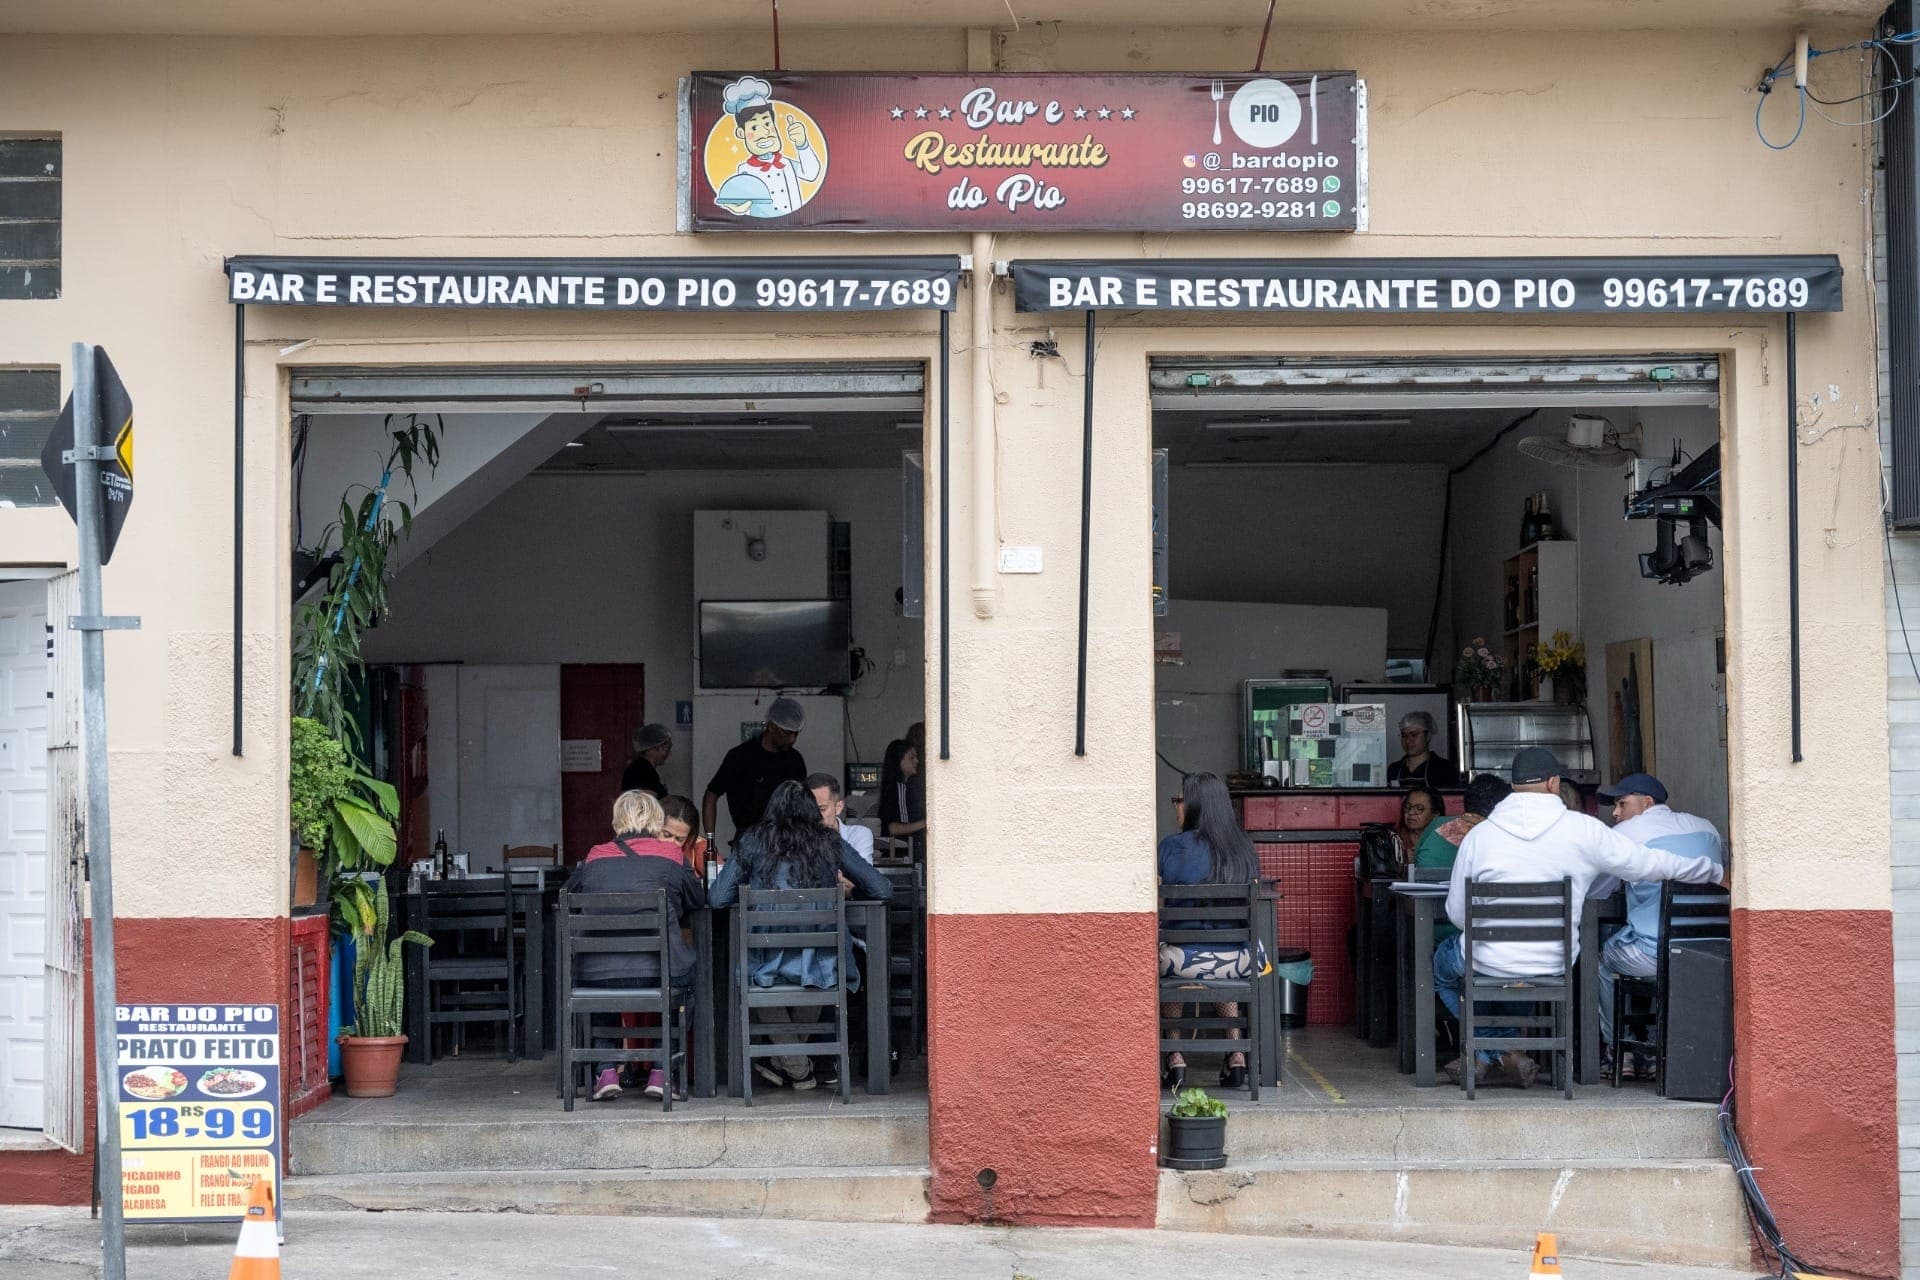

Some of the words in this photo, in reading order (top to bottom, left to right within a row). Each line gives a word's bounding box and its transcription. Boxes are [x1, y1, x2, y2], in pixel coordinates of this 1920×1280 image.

[961, 87, 1039, 128] Bar
[1045, 100, 1064, 123] e
[1250, 105, 1279, 123] PIO
[904, 131, 1109, 173] Restaurante
[1203, 152, 1339, 171] @_bardopio
[948, 176, 987, 208] do
[996, 174, 1065, 212] Pio
[1182, 177, 1318, 194] 99617-7689
[1182, 202, 1316, 218] 98692-9281
[232, 271, 304, 302] BAR
[316, 275, 337, 303] E
[349, 275, 605, 306] RESTAURANTE
[617, 277, 665, 306] DO
[678, 278, 737, 307] PIO
[756, 278, 951, 307] 99617-7689
[1049, 277, 1124, 306] BAR
[1136, 278, 1157, 306] E
[1170, 278, 1438, 309] RESTAURANTE
[1450, 279, 1501, 309] DO
[1514, 279, 1575, 309] PIO
[1603, 277, 1809, 309] 99617-7689
[116, 1007, 169, 1022] BAR
[178, 1007, 217, 1022] DO
[225, 1007, 272, 1022] PIO
[139, 1023, 246, 1032] RESTAURANTE
[117, 1039, 196, 1059] PRATO
[204, 1038, 274, 1059] FEITO
[201, 1154, 230, 1168] FRANGO
[232, 1154, 241, 1168] AO
[244, 1153, 269, 1167] MOLHO
[201, 1174, 230, 1187] FRANGO
[123, 1199, 167, 1210] ALABRESA
[217, 1194, 226, 1207] DE
